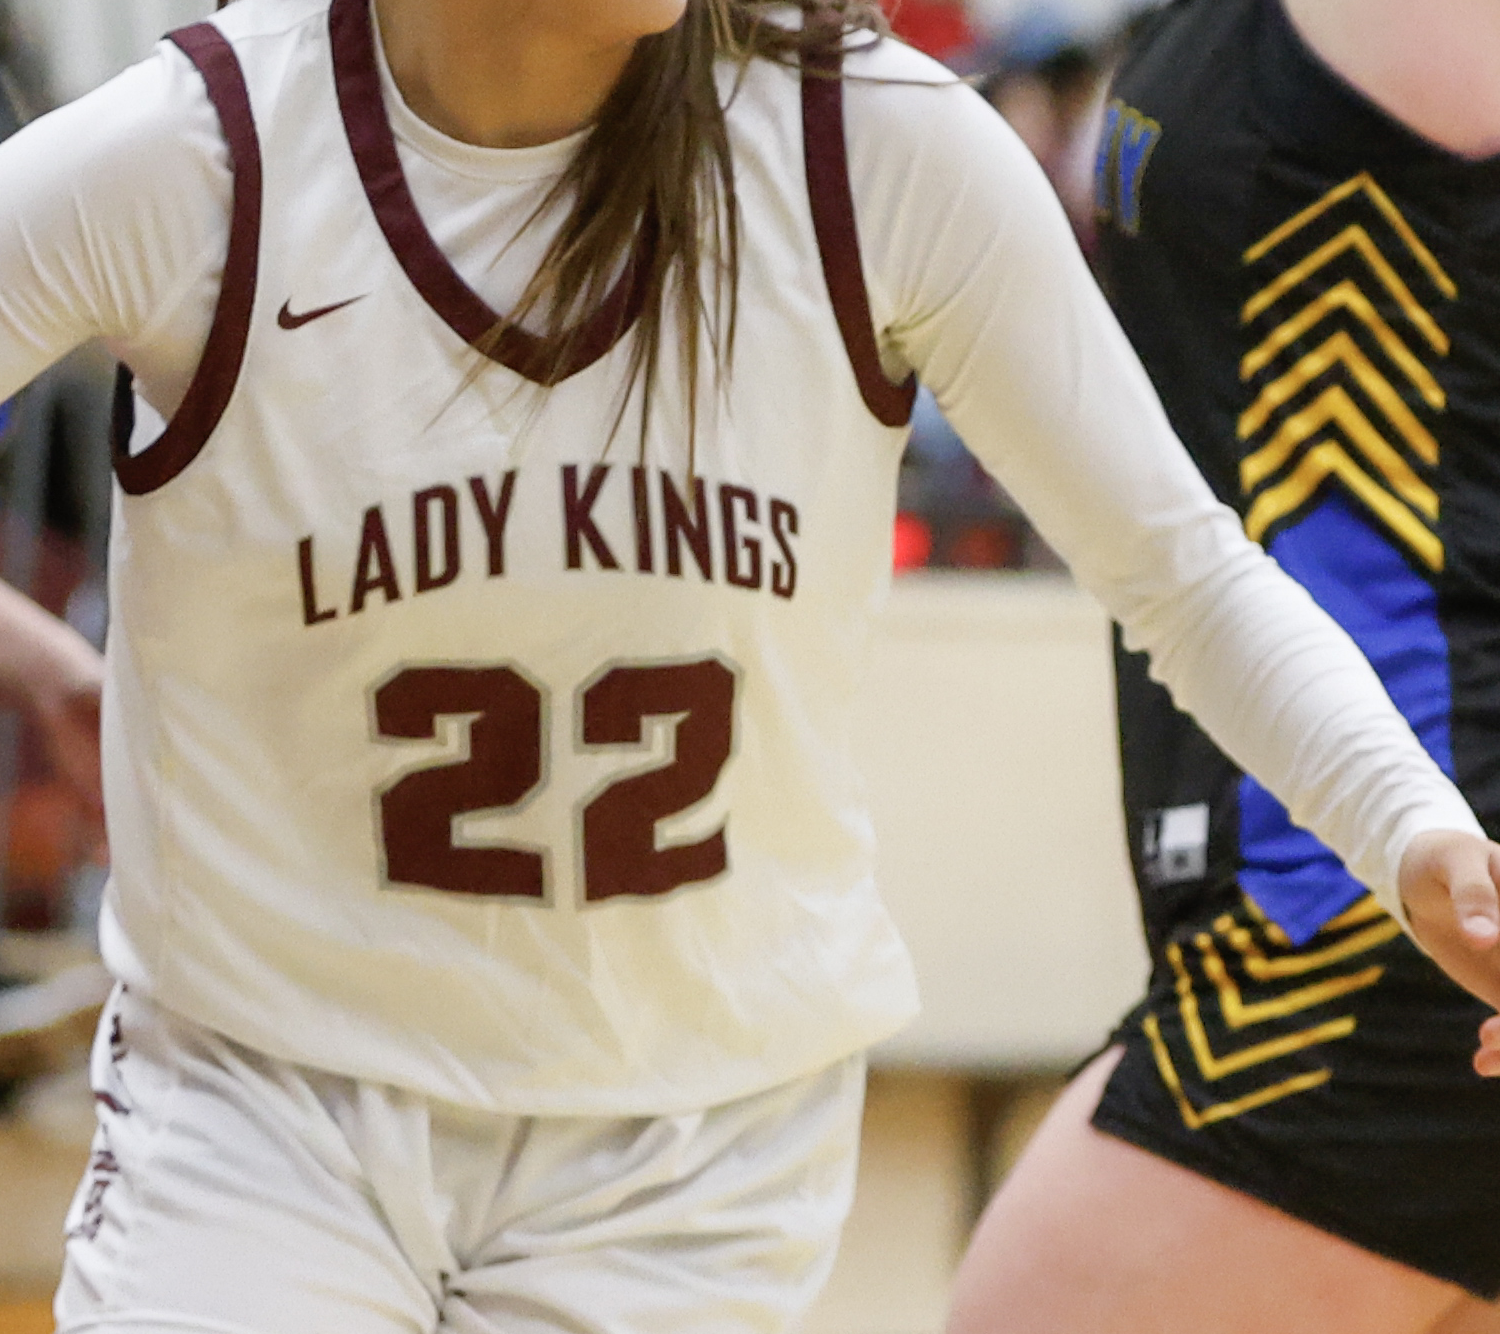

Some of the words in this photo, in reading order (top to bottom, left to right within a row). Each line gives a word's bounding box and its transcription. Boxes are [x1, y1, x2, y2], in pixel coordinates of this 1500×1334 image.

[297, 467, 520, 627] LADY
[560, 461, 803, 602] KINGS
[366, 653, 745, 908] 22
